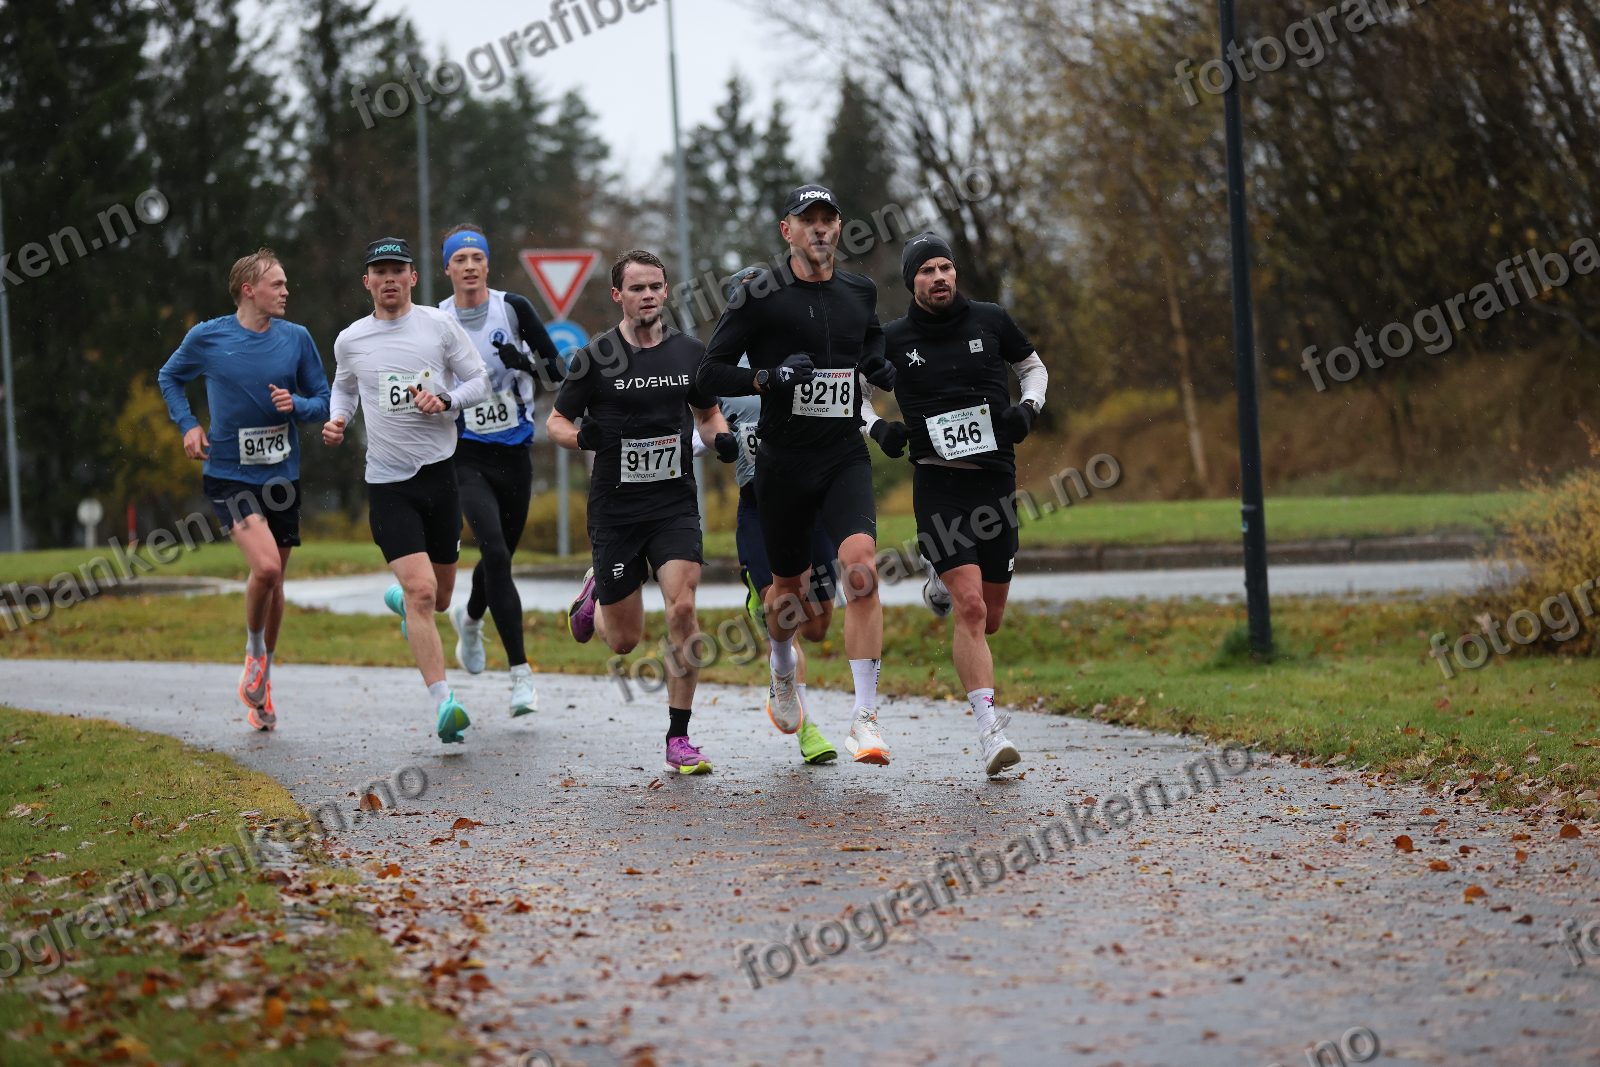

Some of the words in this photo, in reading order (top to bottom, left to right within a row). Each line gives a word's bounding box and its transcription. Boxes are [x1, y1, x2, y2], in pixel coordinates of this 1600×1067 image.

[799, 190, 832, 202] HOKA
[374, 244, 402, 256] HOKA
[800, 381, 850, 405] 9218
[475, 403, 508, 426] 548
[244, 433, 285, 456] 9478
[626, 437, 677, 448] NORGESTESTEN
[943, 421, 982, 449] 546
[627, 446, 676, 472] 9177
